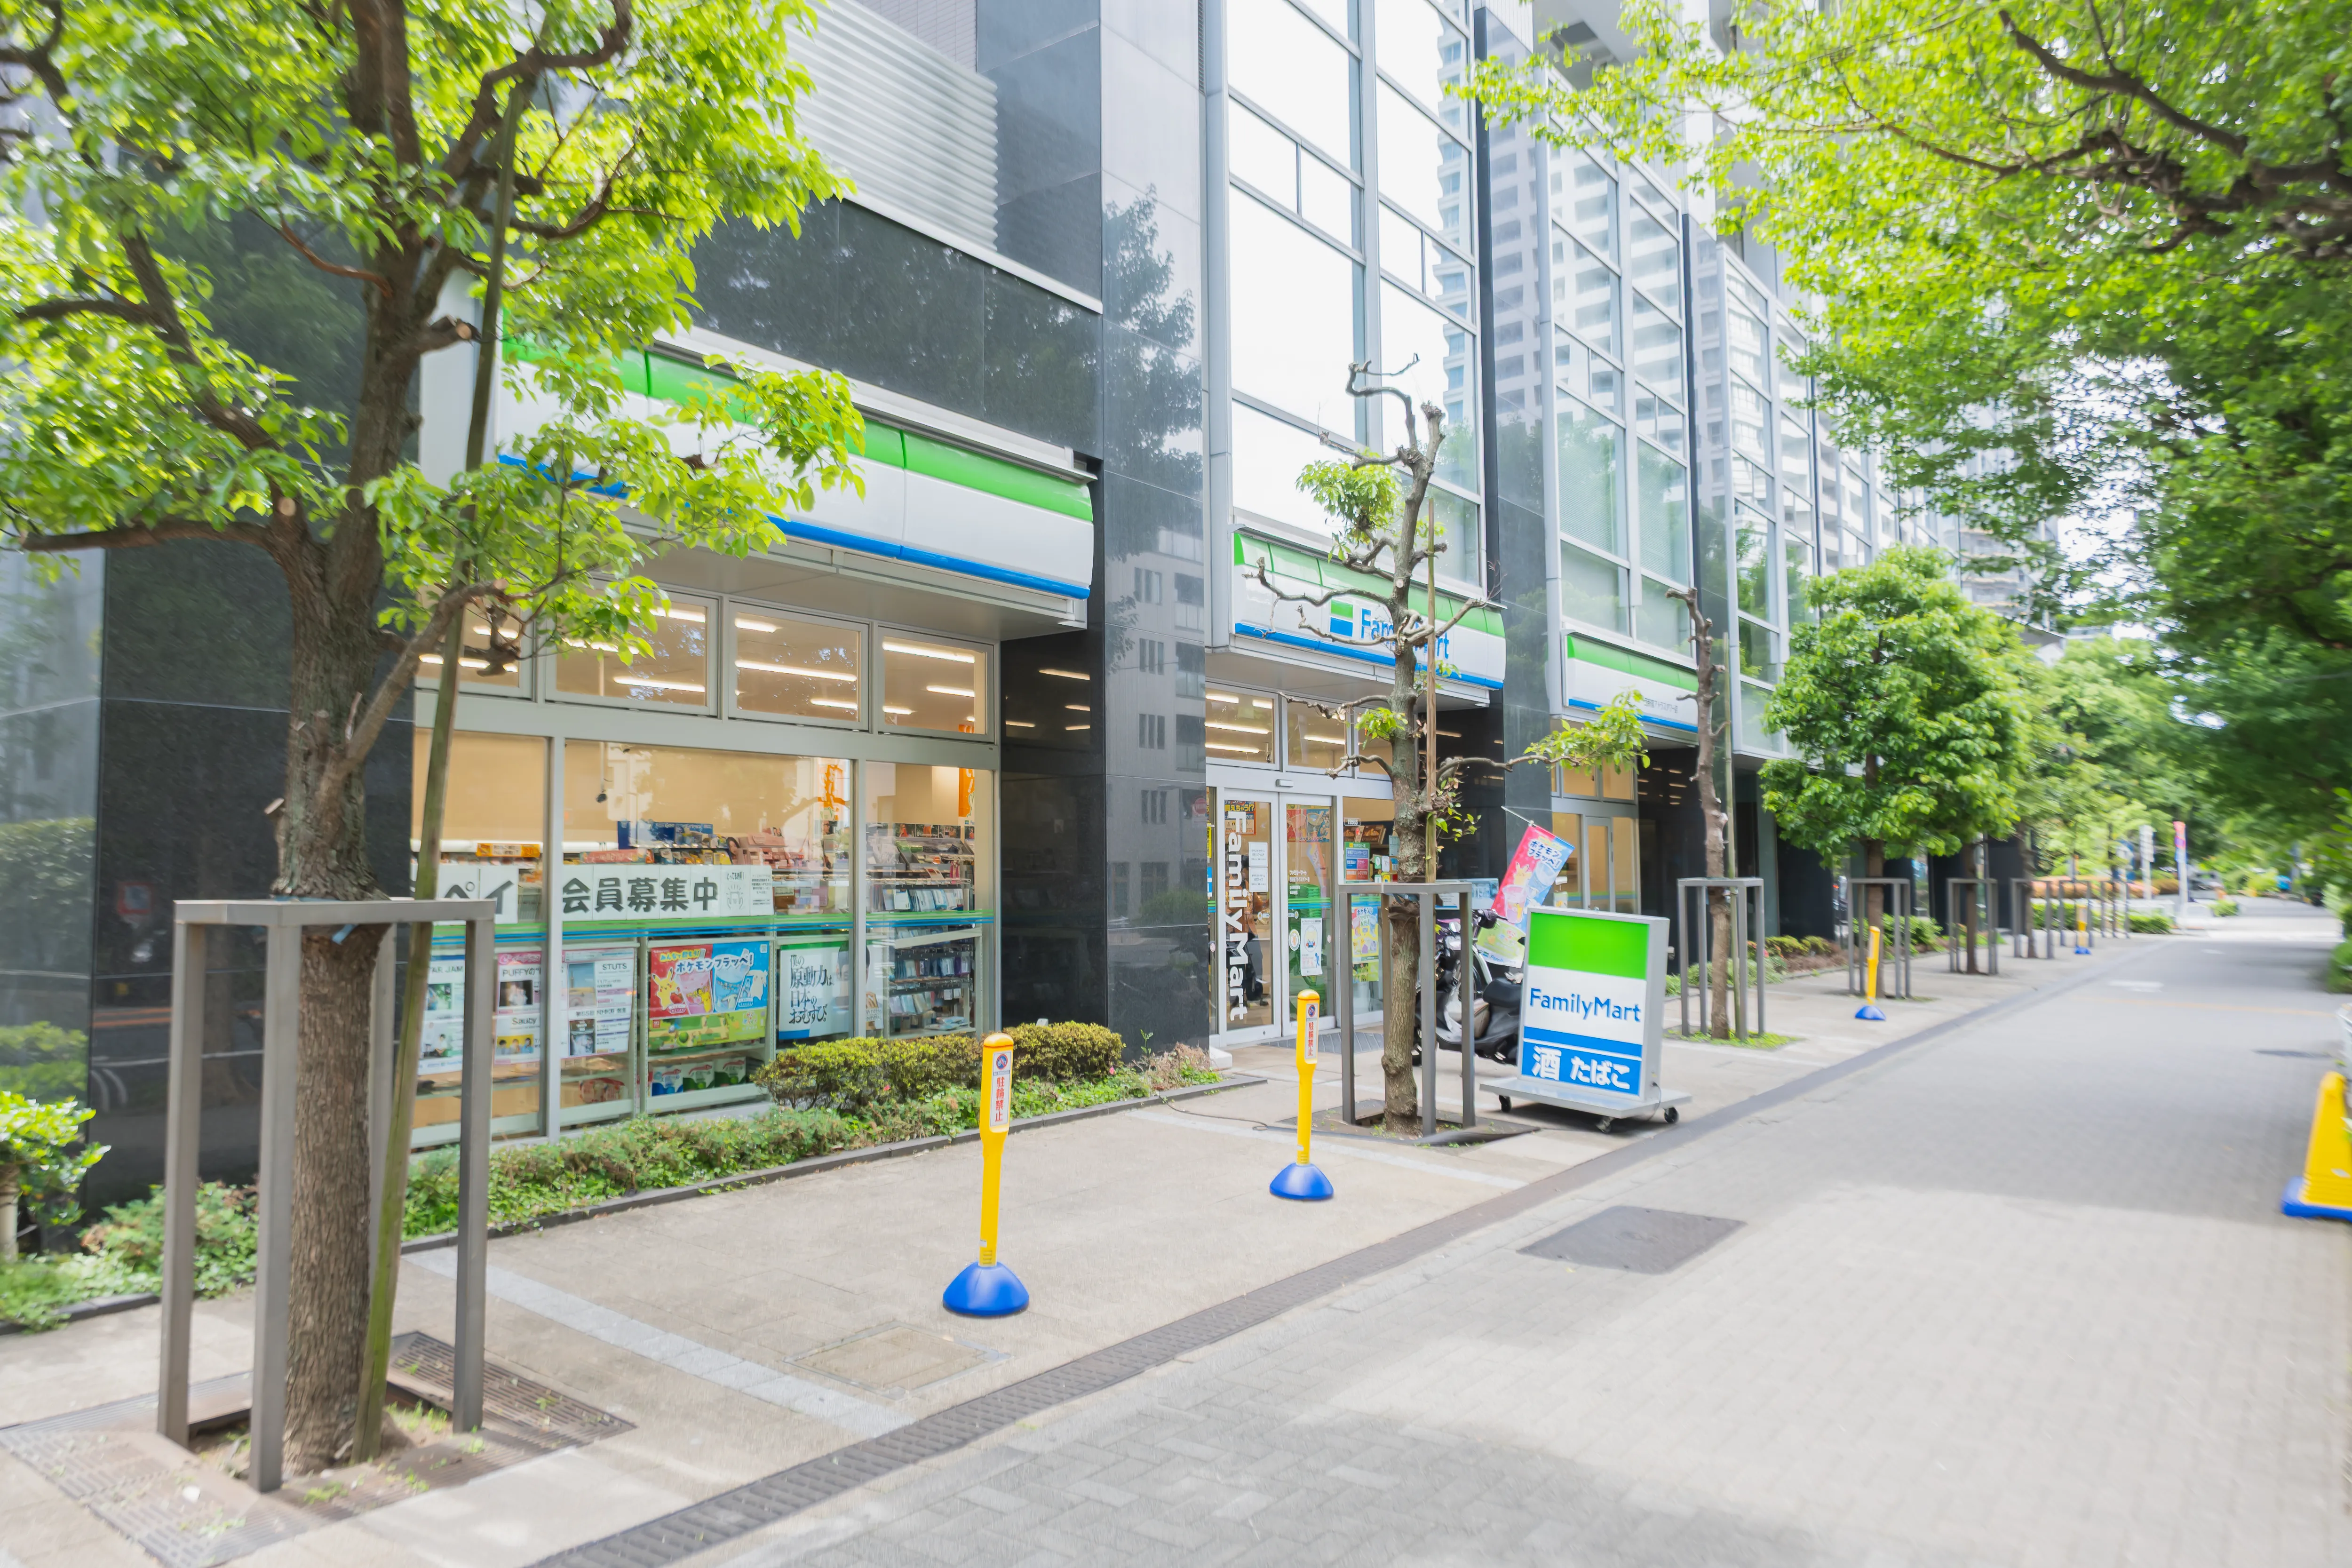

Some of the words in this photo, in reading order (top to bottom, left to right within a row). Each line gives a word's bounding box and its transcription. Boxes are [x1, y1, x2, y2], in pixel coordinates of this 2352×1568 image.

[1361, 608, 1449, 659] Famrt
[1528, 848, 1562, 868] フラッペ!
[1531, 841, 1561, 858] ポケモン
[563, 877, 718, 914] 会員募集中
[1225, 811, 1248, 1021] FamilyMart
[676, 954, 753, 973] ポケモンフラッペ!
[791, 988, 817, 1008] 日本の
[1530, 988, 1642, 1022] FamilyMart
[1532, 1045, 1562, 1081] 酒
[1570, 1056, 1631, 1090] たばこ
[995, 1076, 1005, 1122] 駐輪禁止
